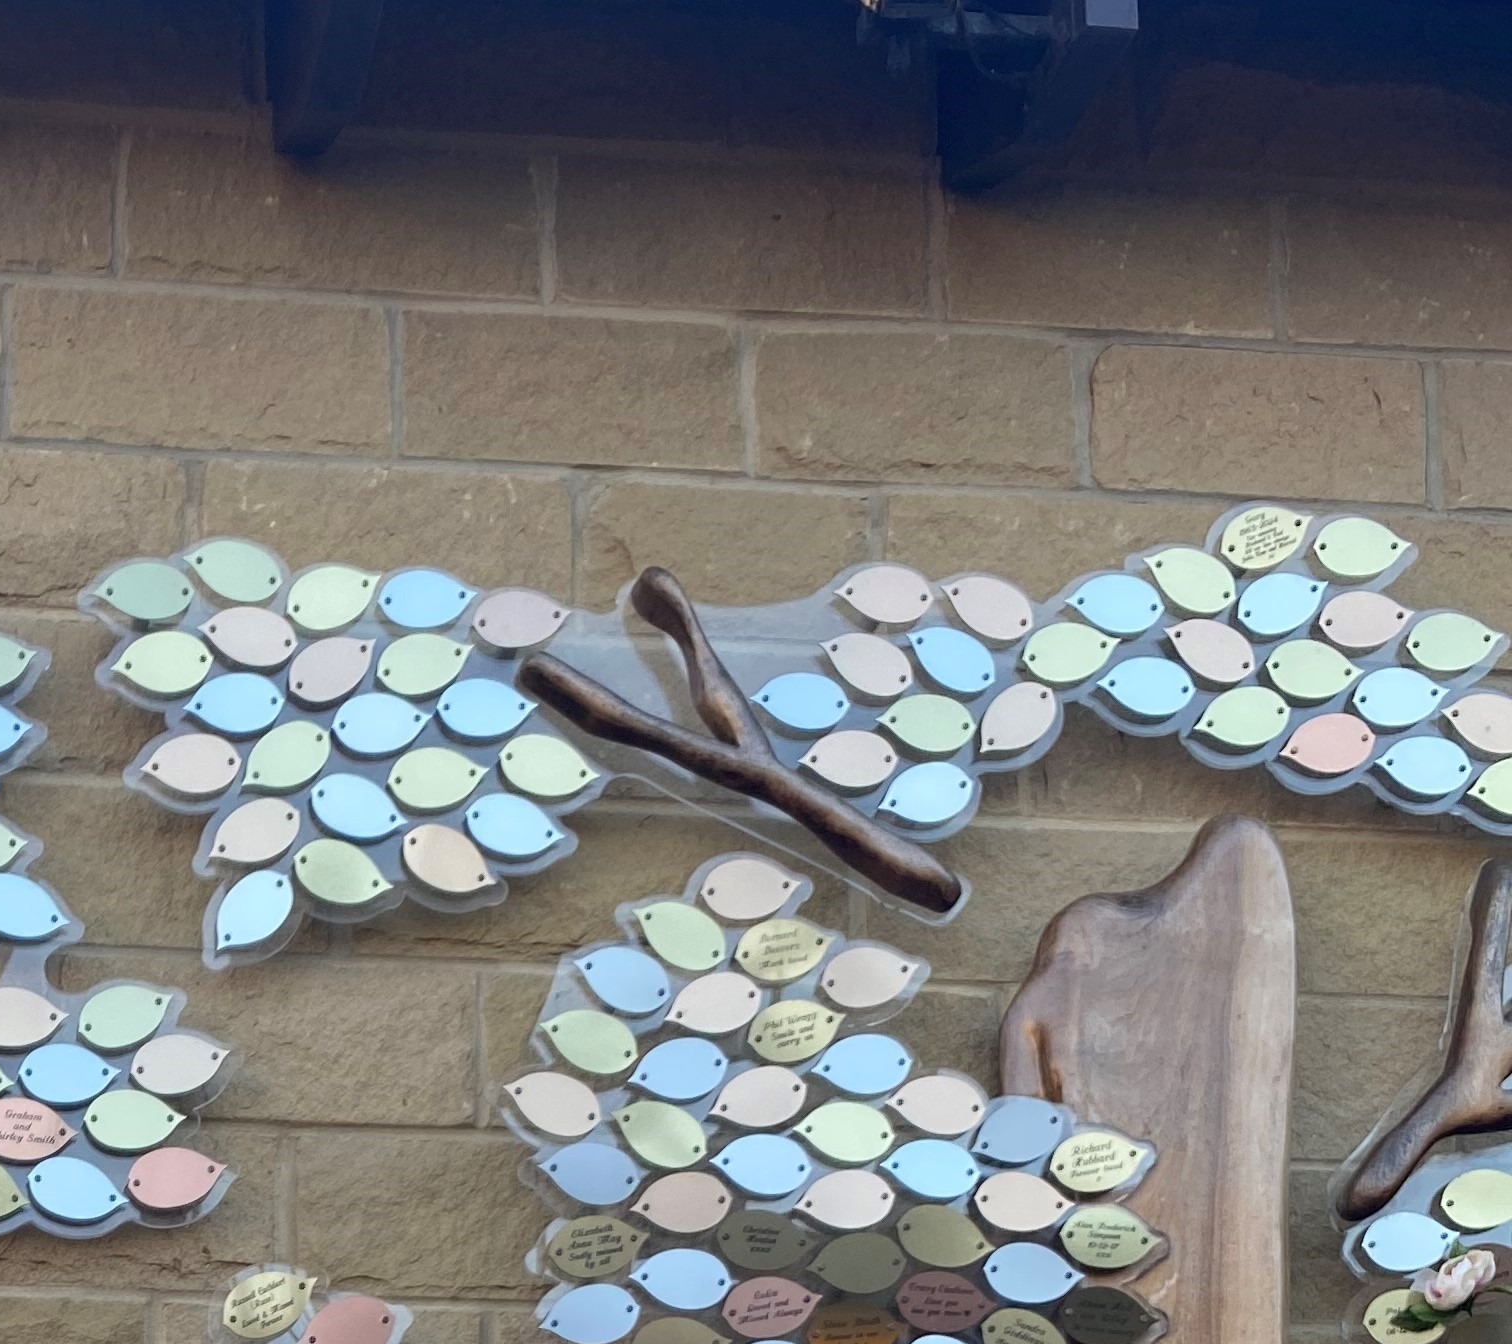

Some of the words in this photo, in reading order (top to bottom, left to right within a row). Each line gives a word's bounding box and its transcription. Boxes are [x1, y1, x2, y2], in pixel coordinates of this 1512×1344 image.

[5, 1109, 43, 1121] Graham
[13, 1122, 32, 1131] and
[27, 1134, 56, 1144] Smith
